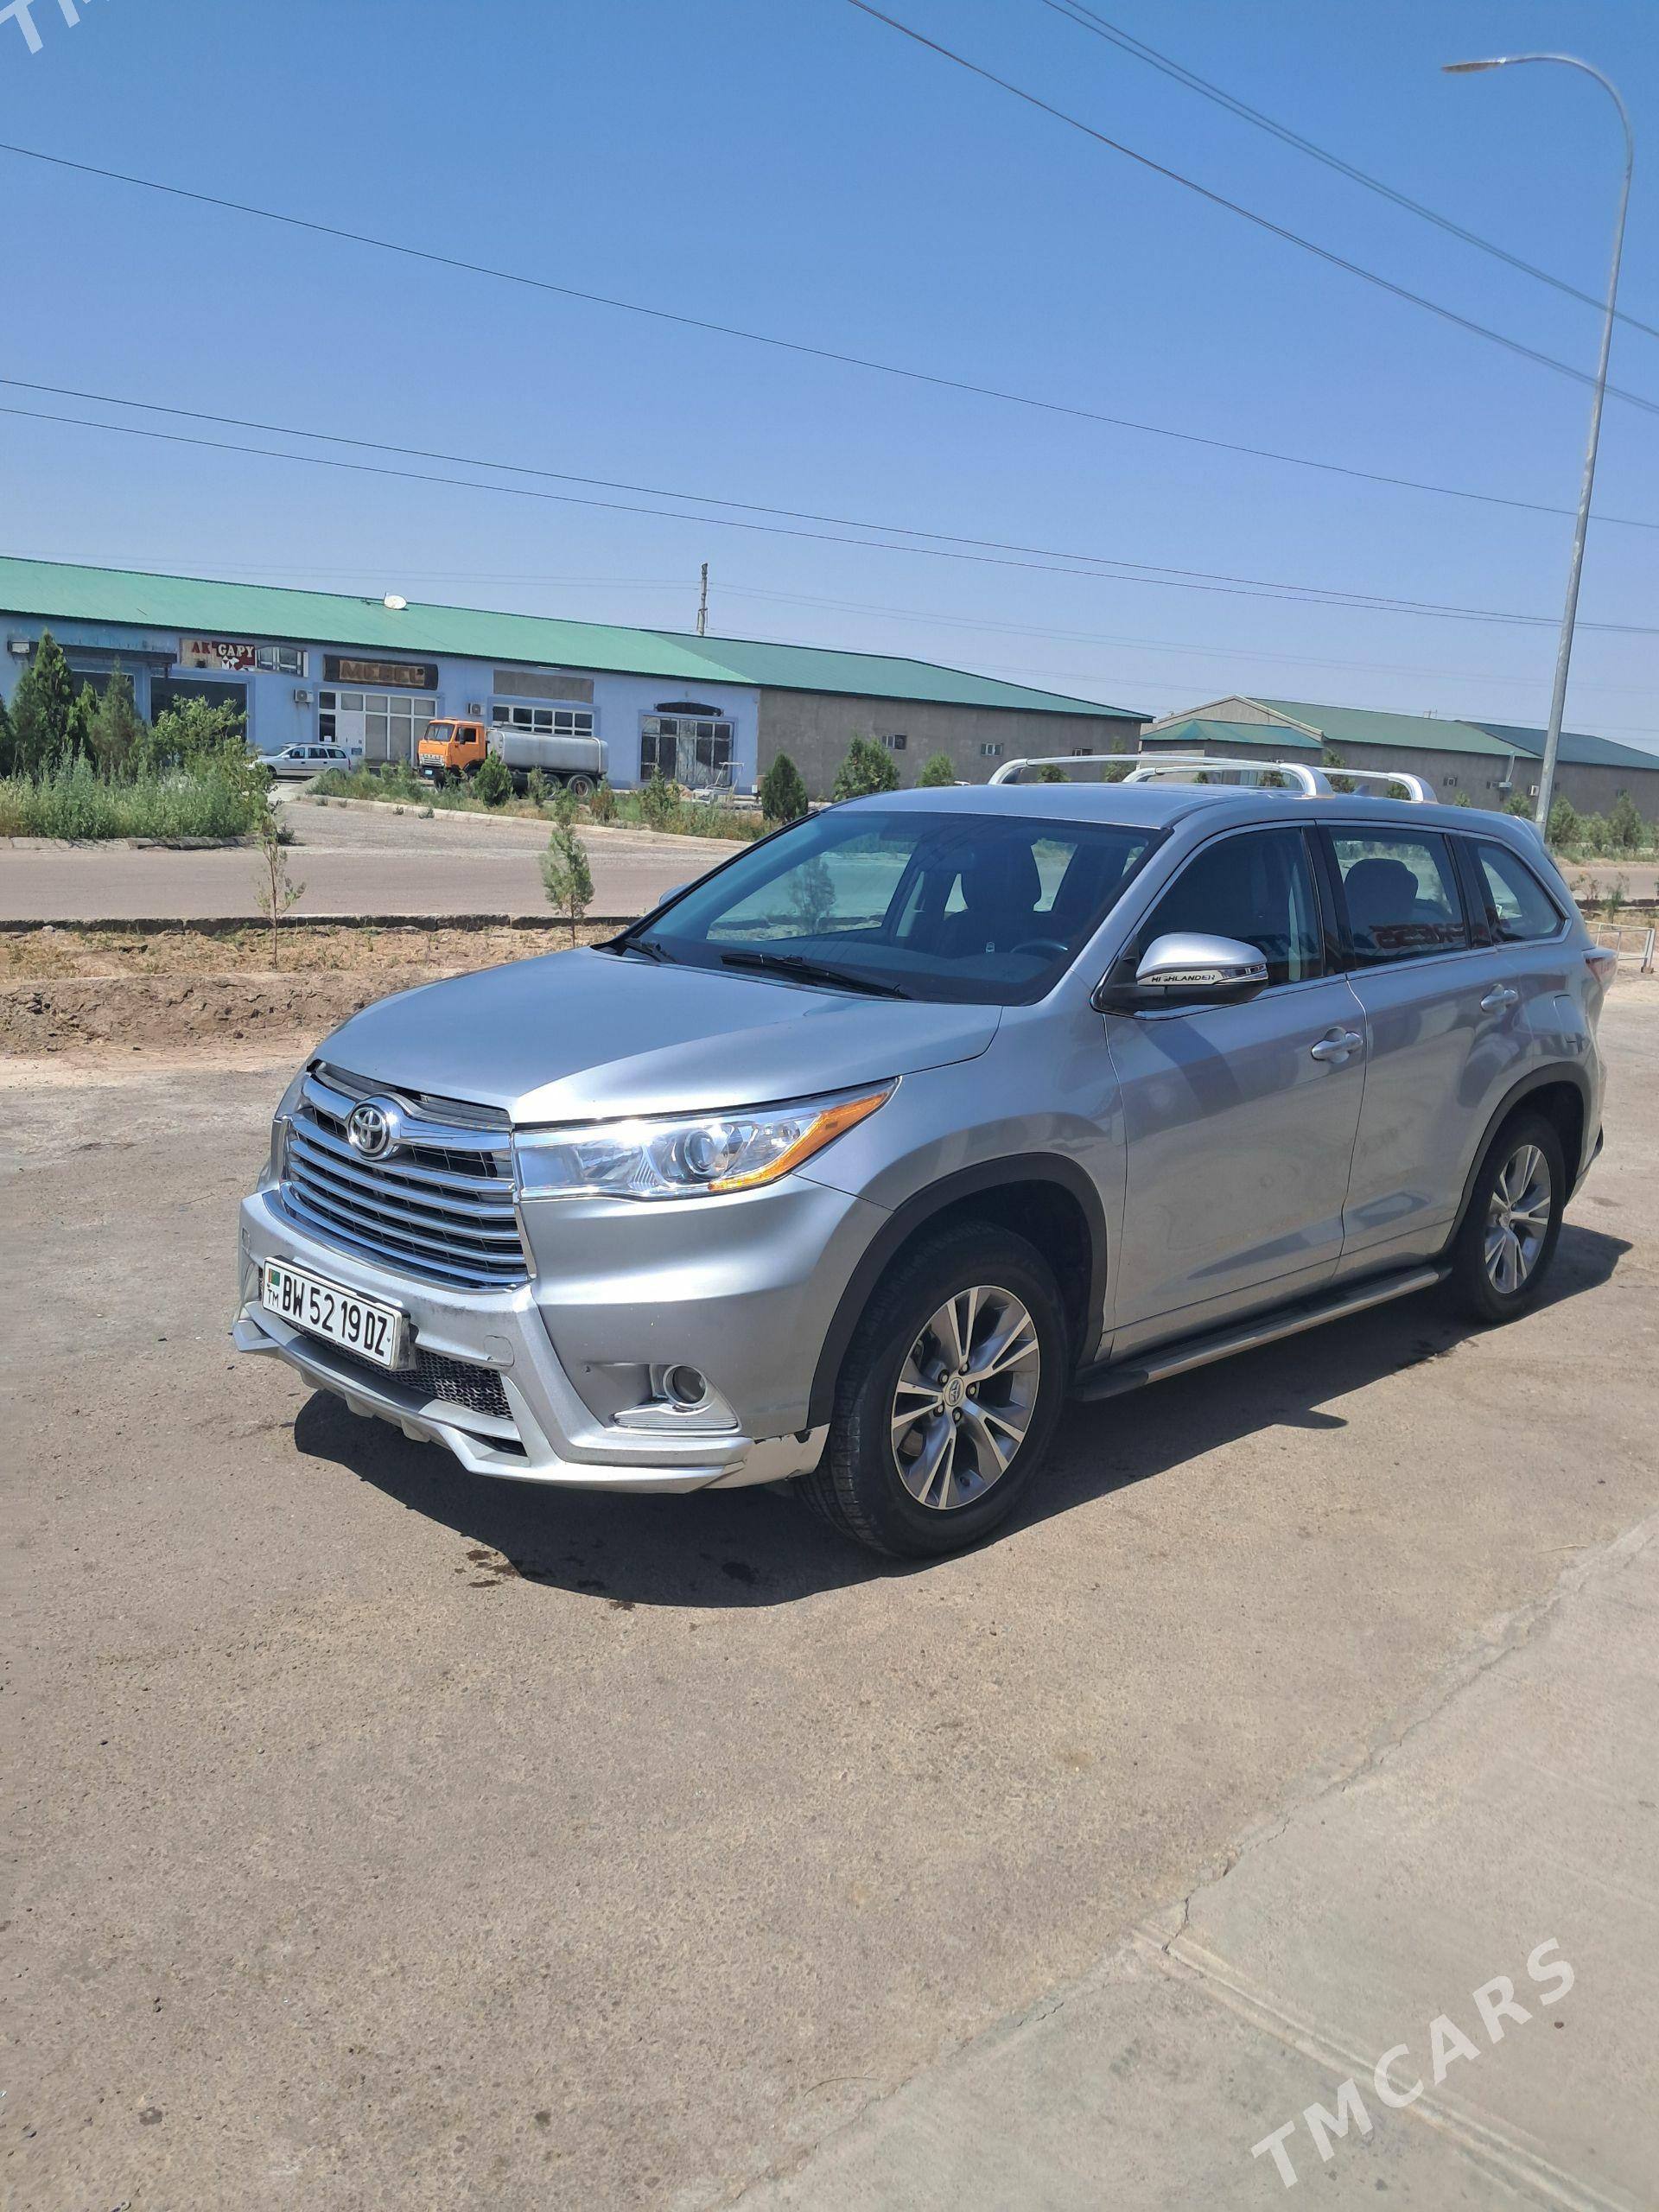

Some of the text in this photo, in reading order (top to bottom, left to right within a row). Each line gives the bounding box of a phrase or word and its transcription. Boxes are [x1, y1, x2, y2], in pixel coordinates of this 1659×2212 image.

[192, 642, 255, 658] AK GAPY
[341, 661, 424, 685] MEBEL
[267, 1287, 279, 1308] TM
